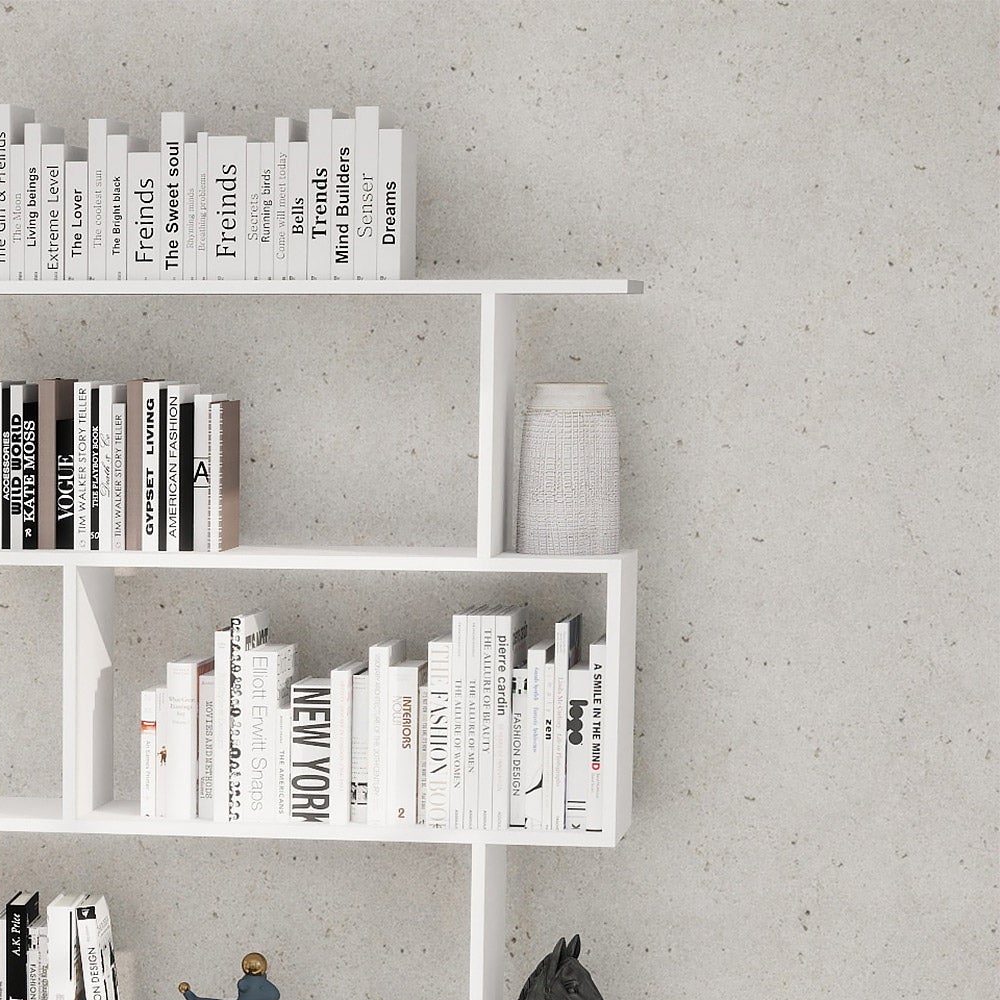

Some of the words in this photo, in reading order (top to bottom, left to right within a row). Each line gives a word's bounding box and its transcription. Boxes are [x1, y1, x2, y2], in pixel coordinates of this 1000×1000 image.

[166, 142, 179, 176] soul
[27, 166, 38, 206] beings
[47, 166, 59, 202] Level
[112, 176, 121, 202] black
[261, 169, 271, 194] birds
[336, 147, 350, 216] Builders
[72, 188, 82, 228] Lover
[112, 205, 122, 234] Bright
[134, 178, 154, 263] Freinds
[166, 182, 179, 233] Sweet
[216, 163, 238, 258] Freinds
[248, 194, 258, 241] Secrets
[261, 200, 272, 242] Running
[292, 198, 304, 234] Bells
[312, 167, 328, 240] Trends
[357, 173, 373, 238] Senser
[382, 181, 396, 245] Dreams
[27, 207, 38, 247] Living
[48, 210, 59, 270] Extreme
[72, 233, 82, 258] The
[112, 238, 120, 256] The
[336, 224, 349, 264] Mind
[166, 240, 179, 270] The
[78, 388, 87, 424] TELLER
[146, 398, 154, 454] LIVING
[24, 420, 36, 470] MOSS
[78, 427, 87, 464] STORY
[169, 396, 178, 458] FASHION
[24, 474, 36, 522] KATE
[58, 454, 74, 520] VOGUE
[78, 467, 87, 511] WALKER
[146, 468, 154, 536] GYPSET
[168, 463, 178, 538] AMERICAN
[78, 514, 87, 534] TIM
[483, 630, 492, 650] THE
[498, 636, 510, 672] pierre
[252, 656, 268, 700] Elliott
[483, 652, 492, 692] ALLURE
[593, 673, 602, 705] SMILE
[483, 695, 491, 710] OF
[497, 676, 509, 716] cardin
[593, 708, 602, 718] IN
[252, 704, 268, 753] Erwitt
[292, 688, 331, 748] NEW
[402, 696, 412, 750] INTERIORS
[430, 692, 448, 774] FASHION
[482, 712, 490, 754] BEAUTY
[513, 712, 522, 756] FASHION
[567, 700, 588, 745] logo
[592, 722, 601, 740] THE
[592, 742, 600, 770] MIND
[252, 757, 268, 812] Snaps
[512, 758, 521, 796] DESIGN
[398, 808, 405, 818] 2
[10, 913, 21, 934] Price
[11, 934, 20, 956] A.K.
[88, 946, 100, 984] DESIGN
